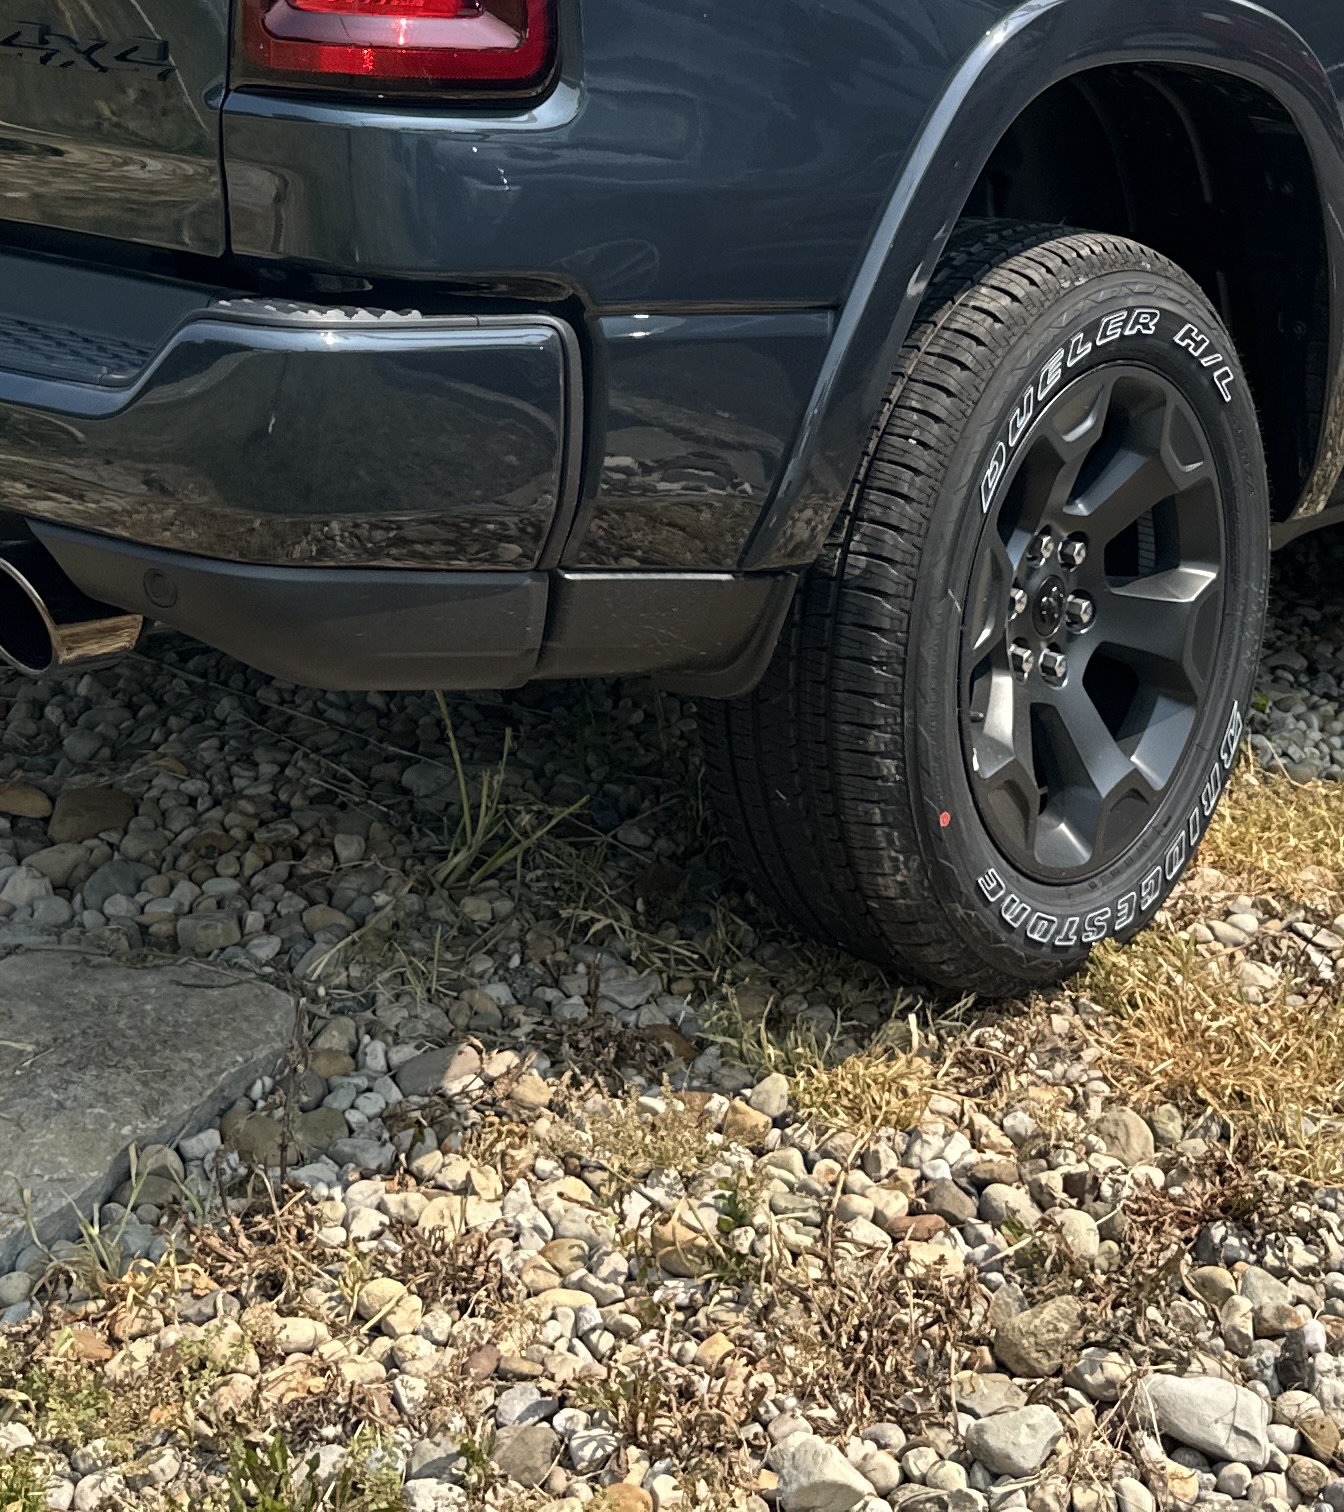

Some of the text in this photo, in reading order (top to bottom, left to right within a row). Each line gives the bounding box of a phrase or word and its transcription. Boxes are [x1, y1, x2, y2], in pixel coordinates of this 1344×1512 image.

[981, 308, 1160, 514] DUELER
[1173, 323, 1234, 403] H/L
[977, 700, 1244, 946] BRIDGESTONE
